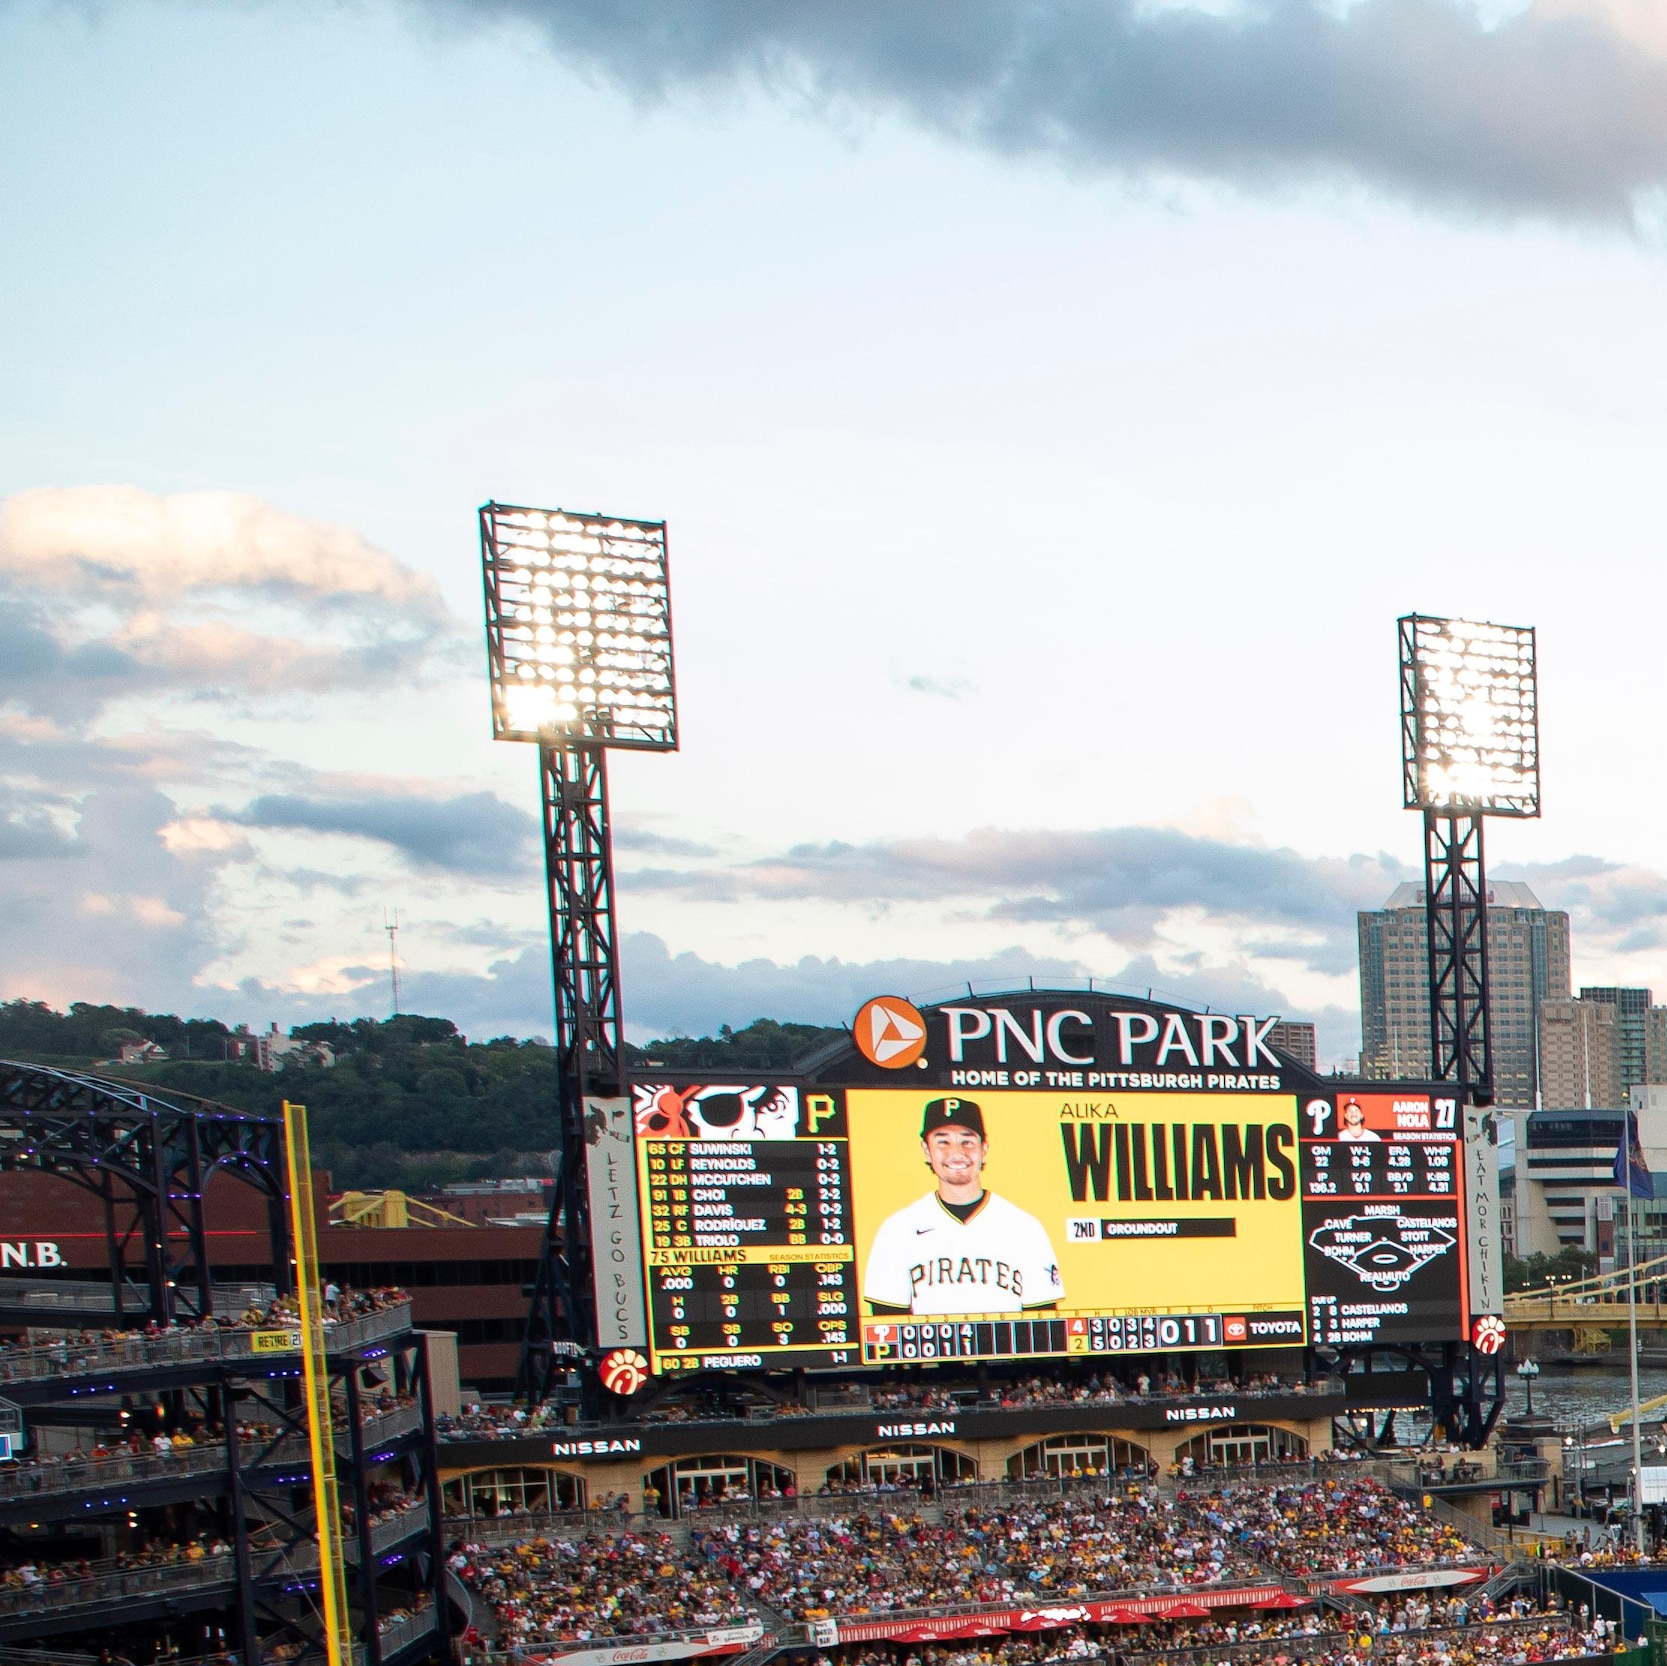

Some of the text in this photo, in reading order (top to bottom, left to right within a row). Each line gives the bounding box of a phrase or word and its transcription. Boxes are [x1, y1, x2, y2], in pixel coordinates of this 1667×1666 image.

[940, 1007, 1283, 1069] PNC PARK
[952, 1070, 1281, 1090] HOME OF THE PITTSBURGH PIRATES
[1060, 1103, 1119, 1119] ALIKA
[1393, 1101, 1428, 1113] AARON
[1434, 1099, 1456, 1128] 27
[1396, 1114, 1429, 1128] NOLA
[689, 1143, 752, 1155] SUWINSKI
[690, 1158, 756, 1170] REYNOLDS
[1060, 1122, 1296, 1202] WILLIAMS
[691, 1173, 772, 1185] MCCUTCHEN
[691, 1189, 726, 1201] CHOI
[692, 1204, 734, 1216] DAVIS
[1364, 1205, 1400, 1216] MARSH
[694, 1217, 767, 1231] RODRÍGUEZ
[1073, 1221, 1178, 1238] 2ND GROUNDOUT
[1324, 1218, 1457, 1230] CAVE CASTELLANOS
[1475, 1150, 1490, 1309] EAT MOR CHIKIN
[695, 1234, 740, 1246] TRIOLO
[1334, 1231, 1430, 1243] TURNER STOTT
[607, 1152, 629, 1340] LETZ GO BUCS
[1324, 1244, 1447, 1257] BOHM HARPER
[0, 1242, 69, 1268] N.B.
[651, 1249, 747, 1264] 75 WILLIAMS
[769, 1252, 849, 1261] SEASON STATISTICS
[910, 1257, 1023, 1298] PIRATES
[1360, 1272, 1410, 1282] REALMUTO
[1341, 1303, 1408, 1315] CASTELLANOS
[1250, 1321, 1302, 1336] TOYOTA
[1341, 1318, 1380, 1328] HARPER
[258, 1334, 288, 1349] RETIRE
[1342, 1331, 1373, 1342] BOHM
[702, 1355, 762, 1368] PEGUERO
[1165, 1405, 1235, 1421] NISSAN
[878, 1421, 955, 1438] NISSAN
[553, 1438, 641, 1456] NISSAN
[1400, 1575, 1428, 1587] Coca-Cola
[612, 1648, 648, 1662] Coca-Cola
